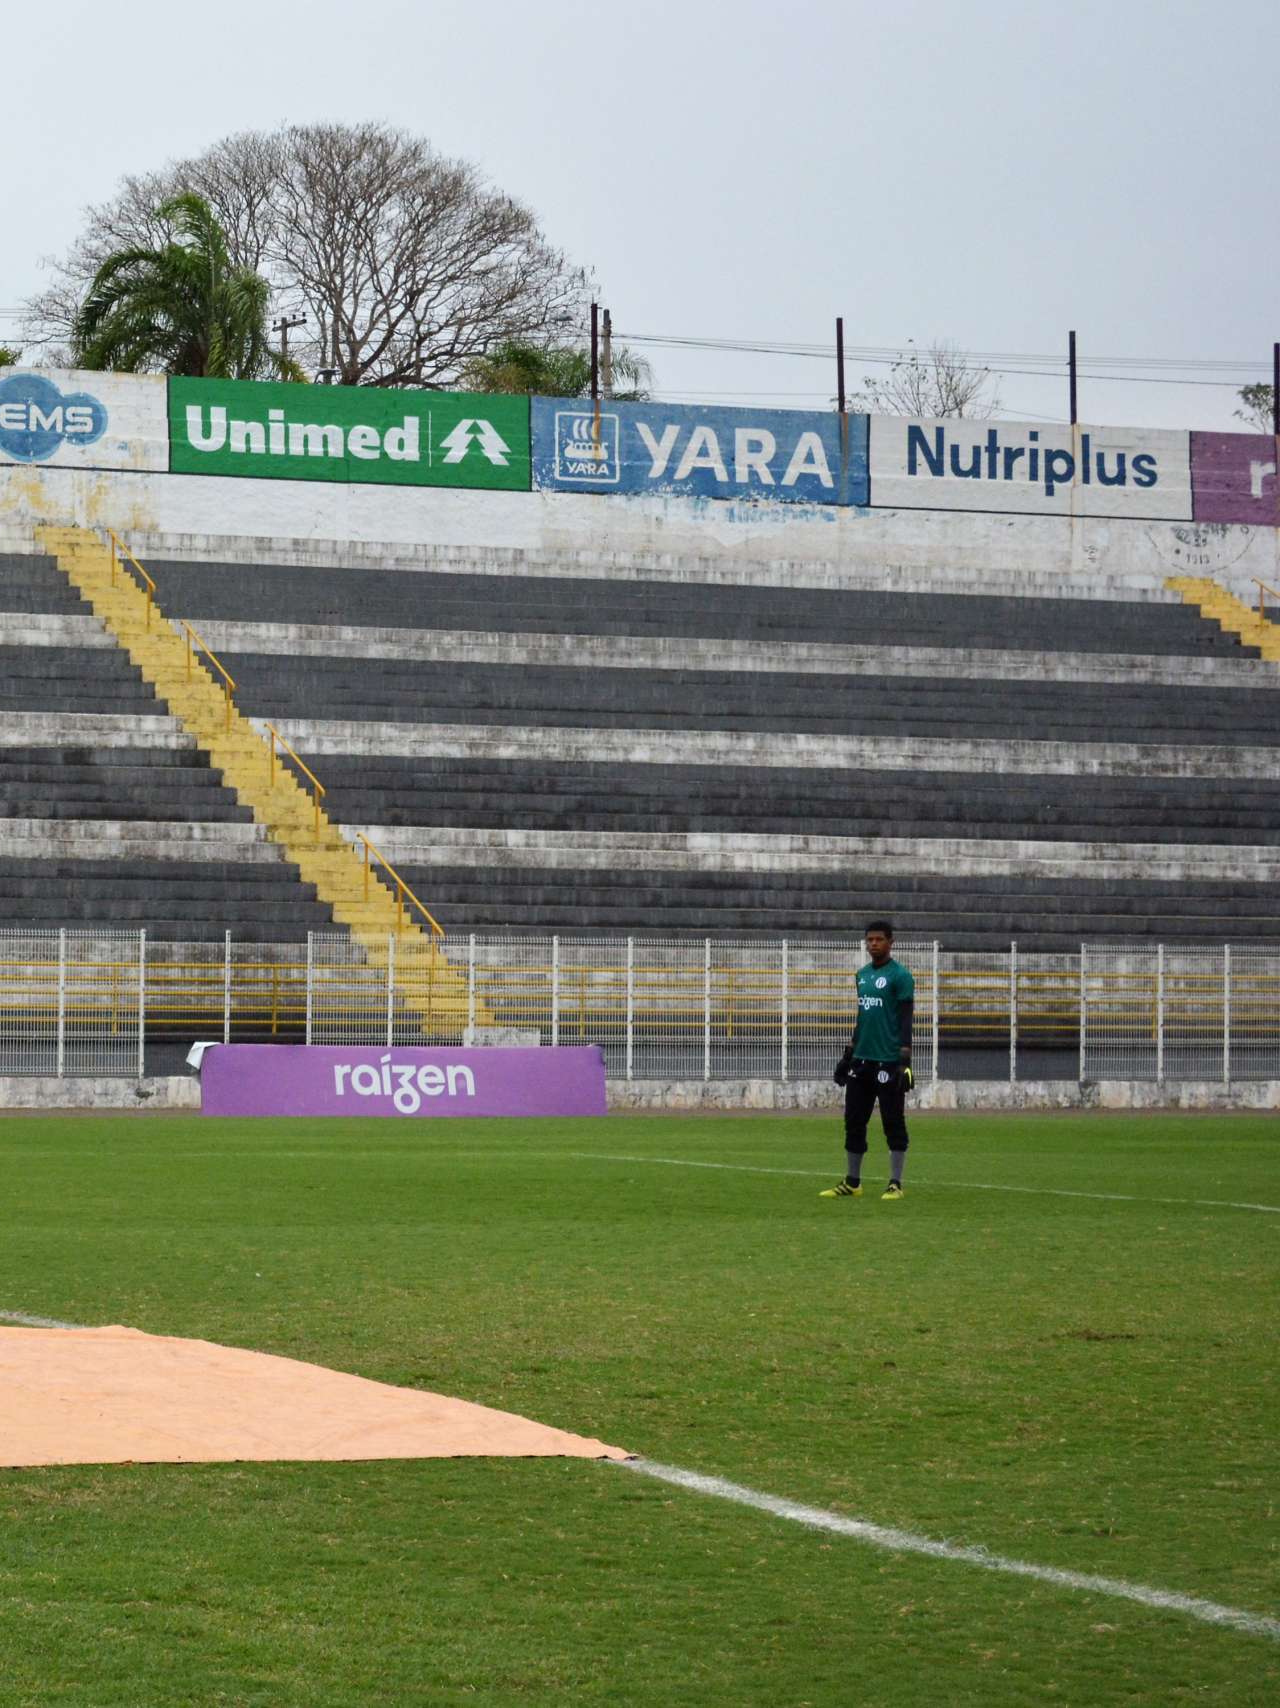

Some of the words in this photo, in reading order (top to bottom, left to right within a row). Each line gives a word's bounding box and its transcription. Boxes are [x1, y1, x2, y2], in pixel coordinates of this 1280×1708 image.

[185, 404, 420, 462] Unimed
[635, 422, 834, 489] YARA
[907, 424, 1158, 497] Nutriplus
[567, 461, 610, 477] YARA
